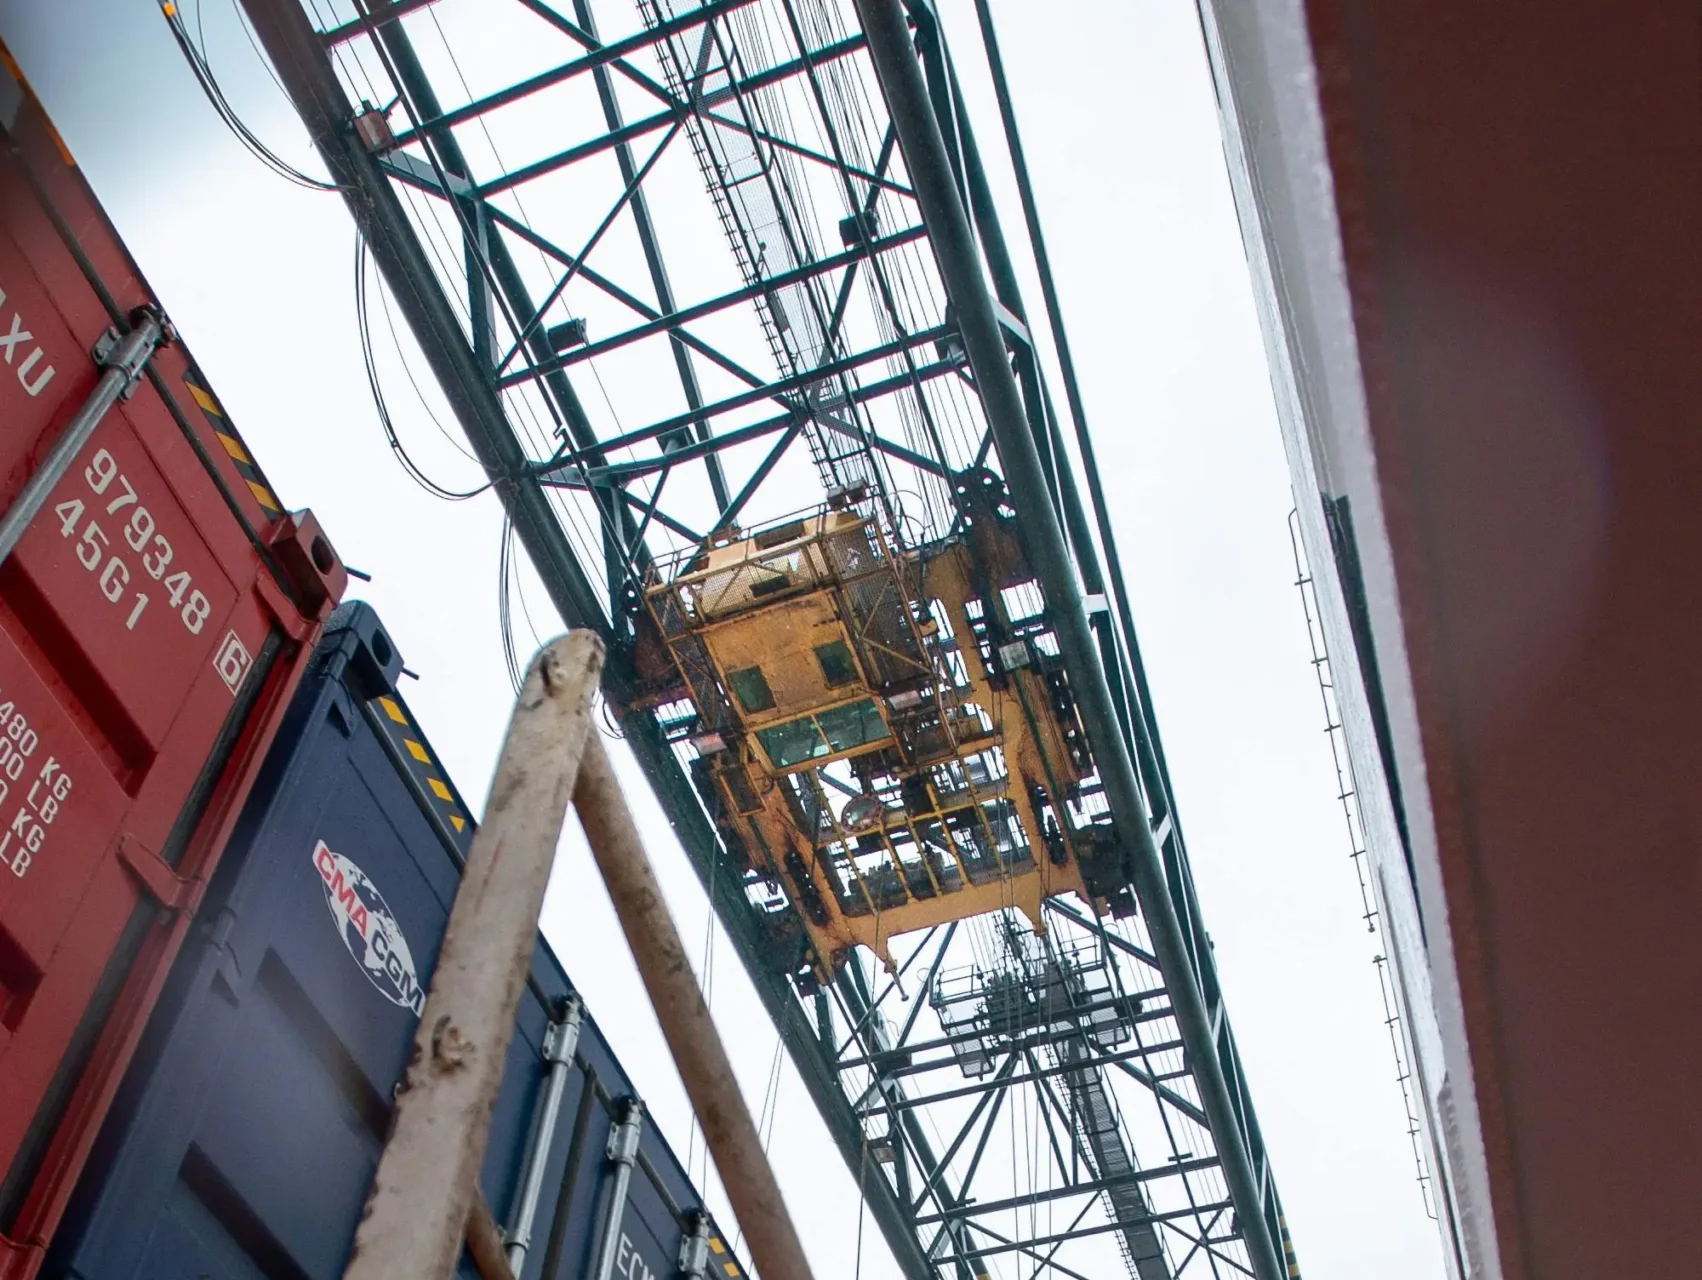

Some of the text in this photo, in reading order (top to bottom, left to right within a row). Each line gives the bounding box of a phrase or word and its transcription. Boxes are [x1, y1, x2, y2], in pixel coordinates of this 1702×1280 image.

[0, 287, 56, 397] XU
[54, 499, 149, 631] 45G1
[84, 448, 247, 686] 979348 6
[27, 779, 59, 824] LB
[40, 756, 73, 801] KG
[0, 831, 31, 878] LB
[11, 807, 46, 853] KG
[316, 847, 423, 1013] CMA CGM
